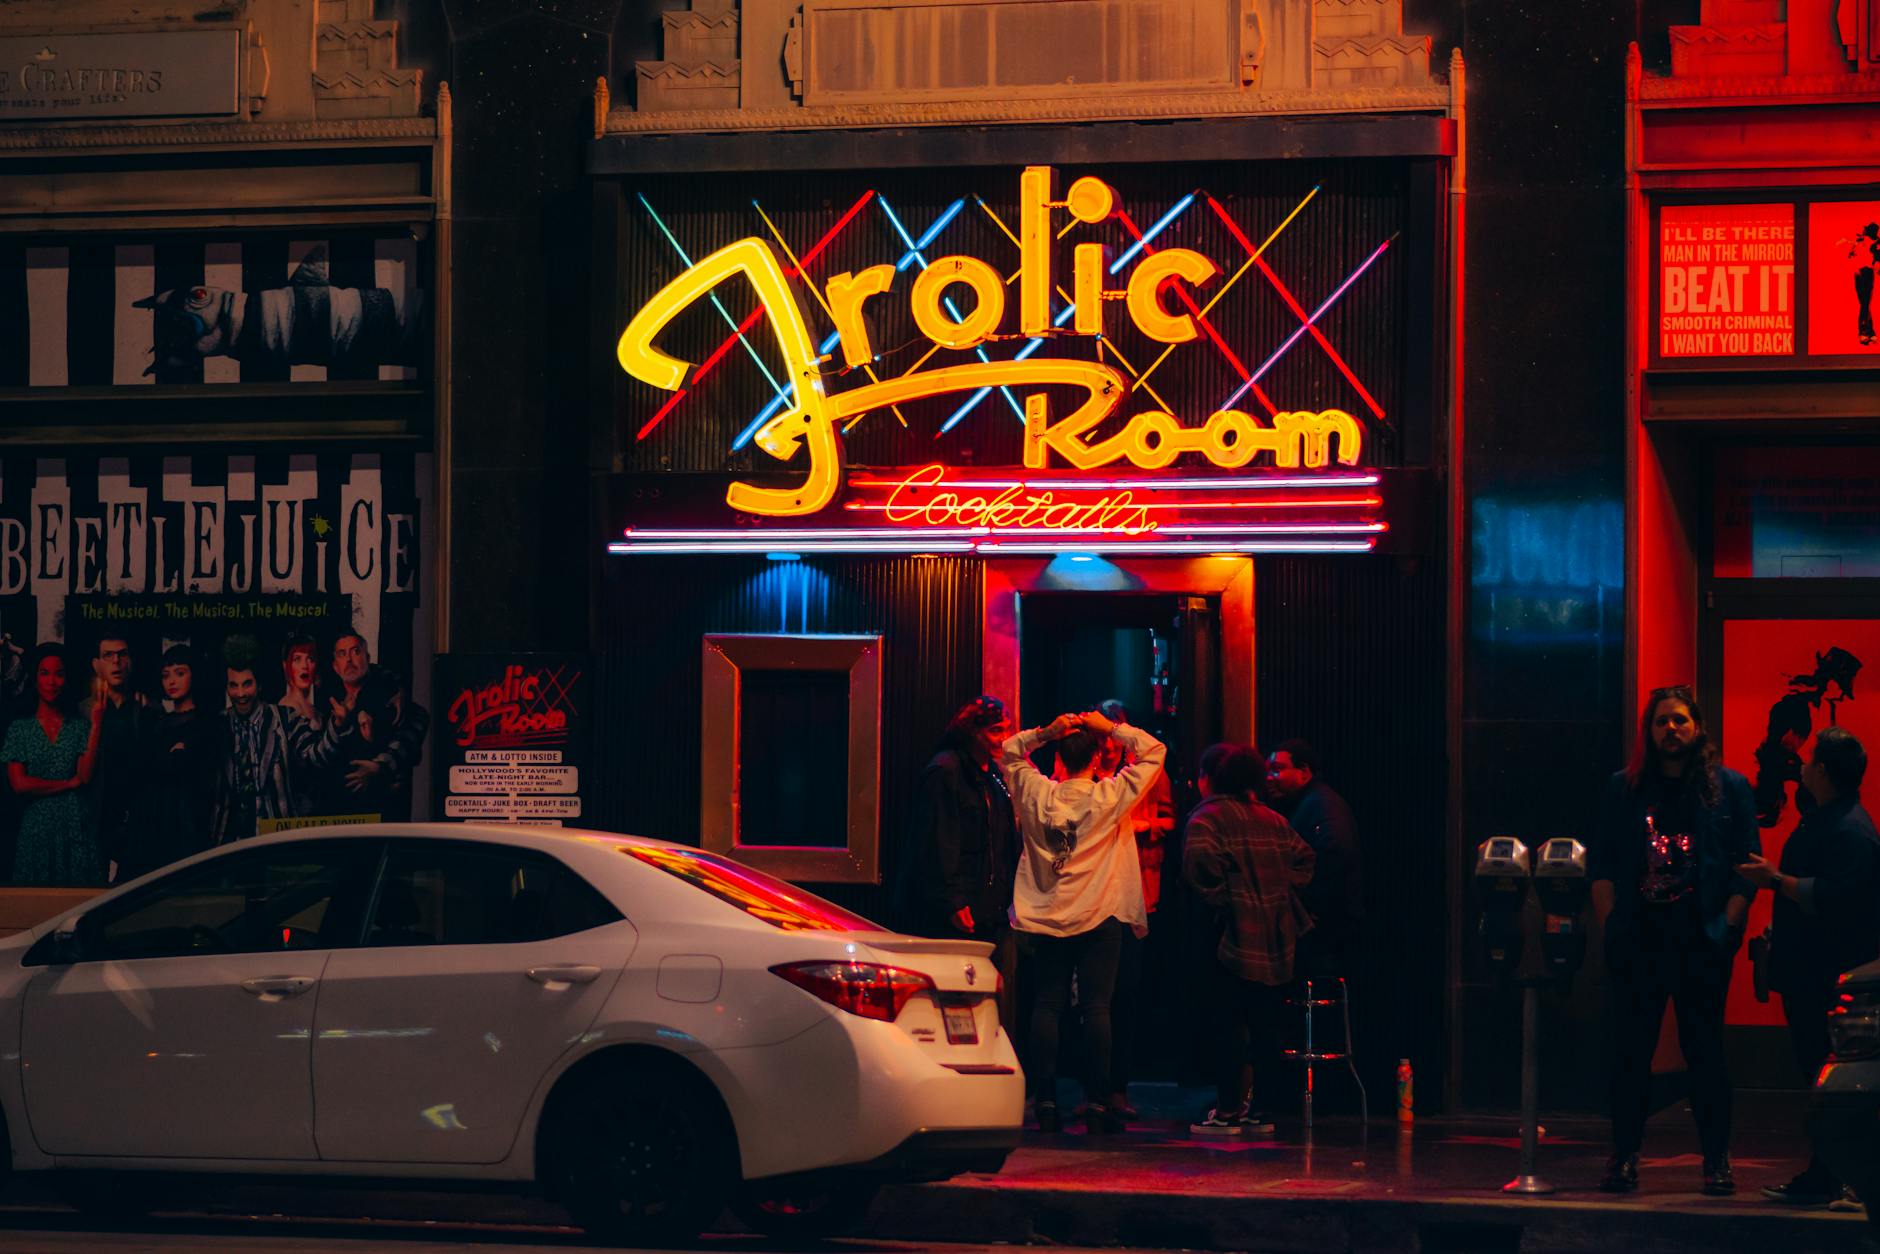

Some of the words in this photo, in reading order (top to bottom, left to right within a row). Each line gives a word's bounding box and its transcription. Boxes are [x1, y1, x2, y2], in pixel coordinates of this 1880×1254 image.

[20, 62, 162, 93] CRAFTERS
[1664, 227, 1697, 241] I'LL
[1702, 227, 1727, 241] BE
[1731, 226, 1794, 240] THERE
[1664, 244, 1694, 262] MAN
[1697, 244, 1711, 262] IN
[1714, 244, 1738, 262] THE
[1742, 243, 1793, 262] MIRROR
[1664, 265, 1750, 314] BEAT
[1759, 264, 1794, 313] IT
[1663, 316, 1722, 330] SMOOTH
[1725, 315, 1792, 330] CRIMINAL
[616, 165, 1224, 516] Frolic
[1664, 333, 1669, 354] I
[1672, 333, 1717, 354] WANT
[1719, 333, 1749, 353] YOU
[1753, 332, 1793, 353] BACK
[1023, 360, 1363, 471] Room
[886, 465, 1158, 535] Cocktails
[81, 603, 104, 620] The
[165, 603, 189, 619] The
[248, 602, 273, 619] The
[447, 664, 539, 747] Frolic
[500, 704, 567, 734] Room
[470, 753, 488, 761] ATM
[491, 753, 497, 761] &
[500, 753, 527, 761] LOTTO
[529, 752, 558, 761] INSIDE
